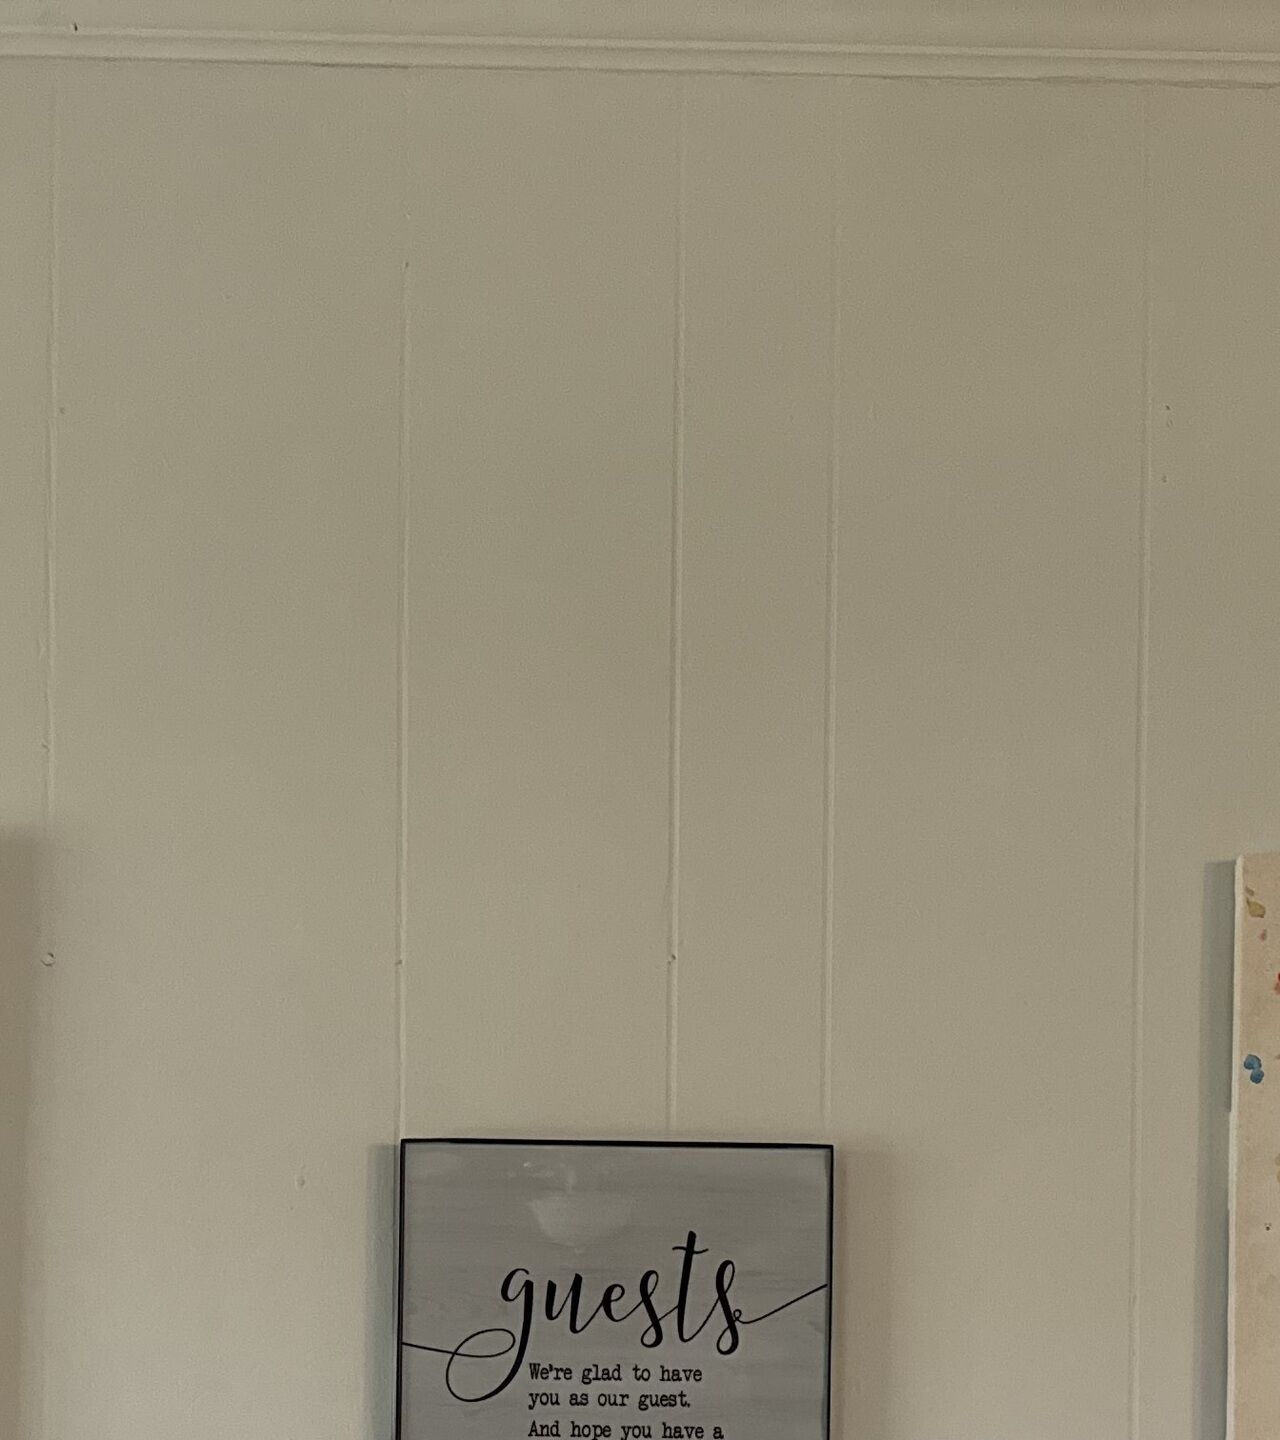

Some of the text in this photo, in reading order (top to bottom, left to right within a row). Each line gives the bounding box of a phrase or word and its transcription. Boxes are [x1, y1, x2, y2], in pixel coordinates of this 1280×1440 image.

[447, 1230, 780, 1402] guests
[528, 1362, 703, 1386] We're glad to have
[527, 1390, 691, 1412] you as our guest.
[527, 1419, 562, 1438] And
[661, 1421, 705, 1440] have
[712, 1426, 725, 1440] a
